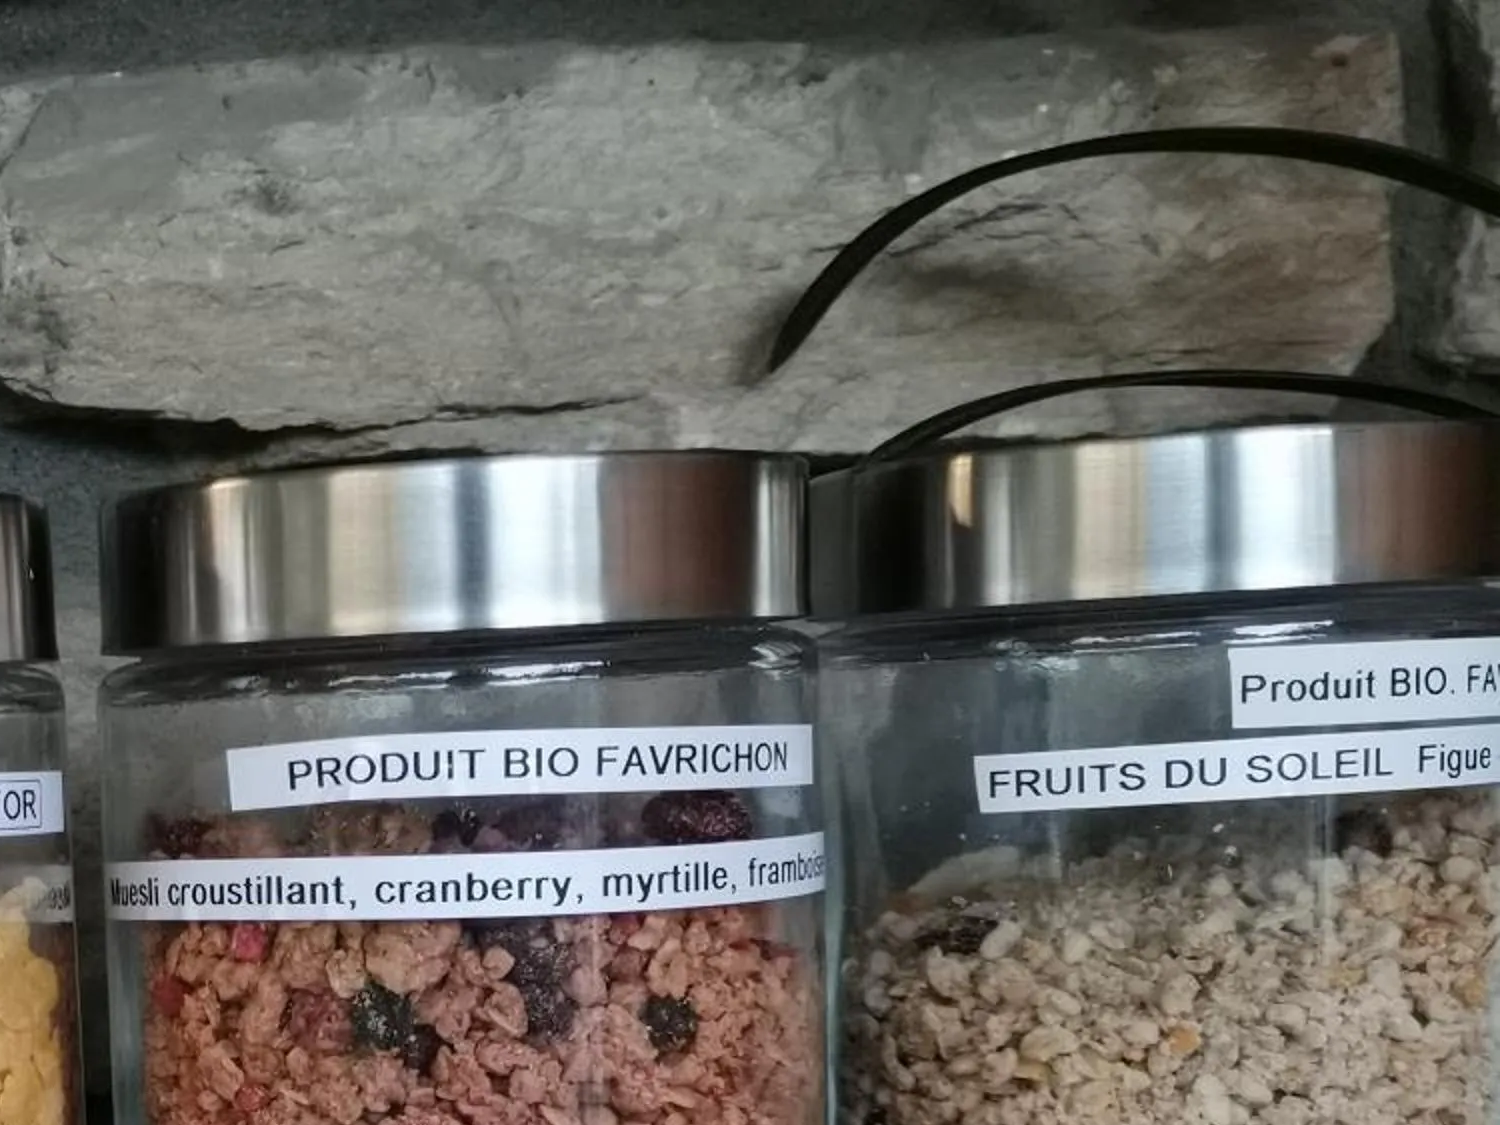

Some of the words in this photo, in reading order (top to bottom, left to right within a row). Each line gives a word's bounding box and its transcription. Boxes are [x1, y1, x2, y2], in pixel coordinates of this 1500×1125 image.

[1241, 670, 1376, 704] Produit
[1390, 667, 1455, 697] BIO.
[288, 749, 486, 790] PRODUIT
[503, 747, 579, 778] BIO
[596, 742, 788, 776] FAVRICHON
[988, 763, 1146, 799] FRUITS
[1165, 757, 1227, 789] DU
[1246, 748, 1393, 784] SOLEIL
[1418, 744, 1491, 778] Figue
[110, 877, 159, 907] Muesli
[167, 876, 357, 910] croustillant,
[375, 873, 584, 911] cranberry,
[603, 861, 737, 900] myrtille,
